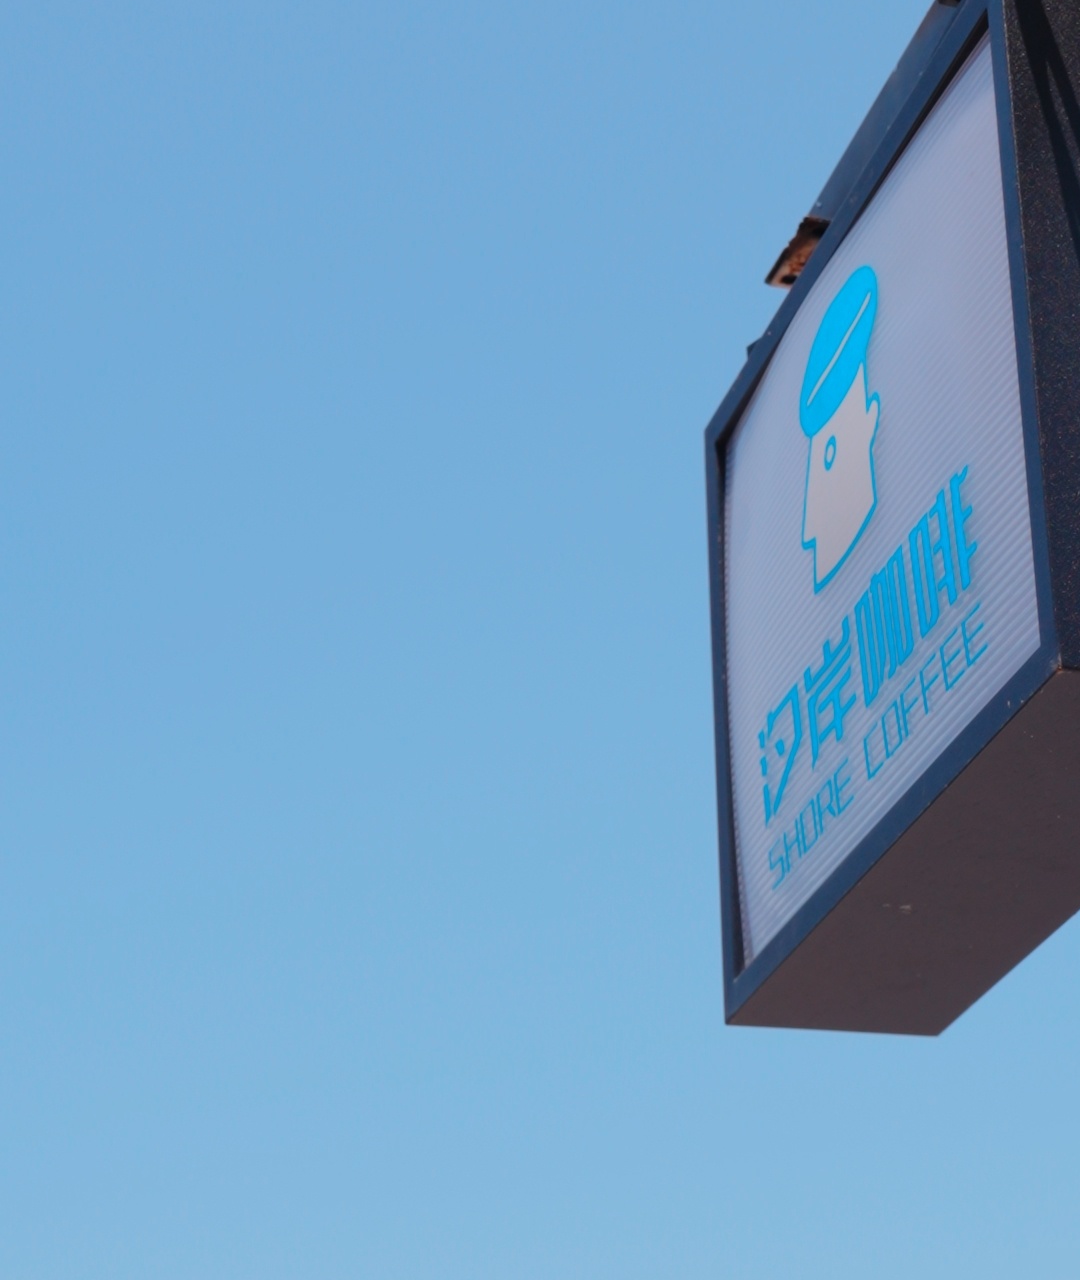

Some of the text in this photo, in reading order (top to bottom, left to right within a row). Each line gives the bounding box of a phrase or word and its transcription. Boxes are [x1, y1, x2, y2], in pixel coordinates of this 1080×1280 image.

[757, 464, 978, 826] 汐岸咖啡
[768, 602, 989, 890] SHORE COFFEE
